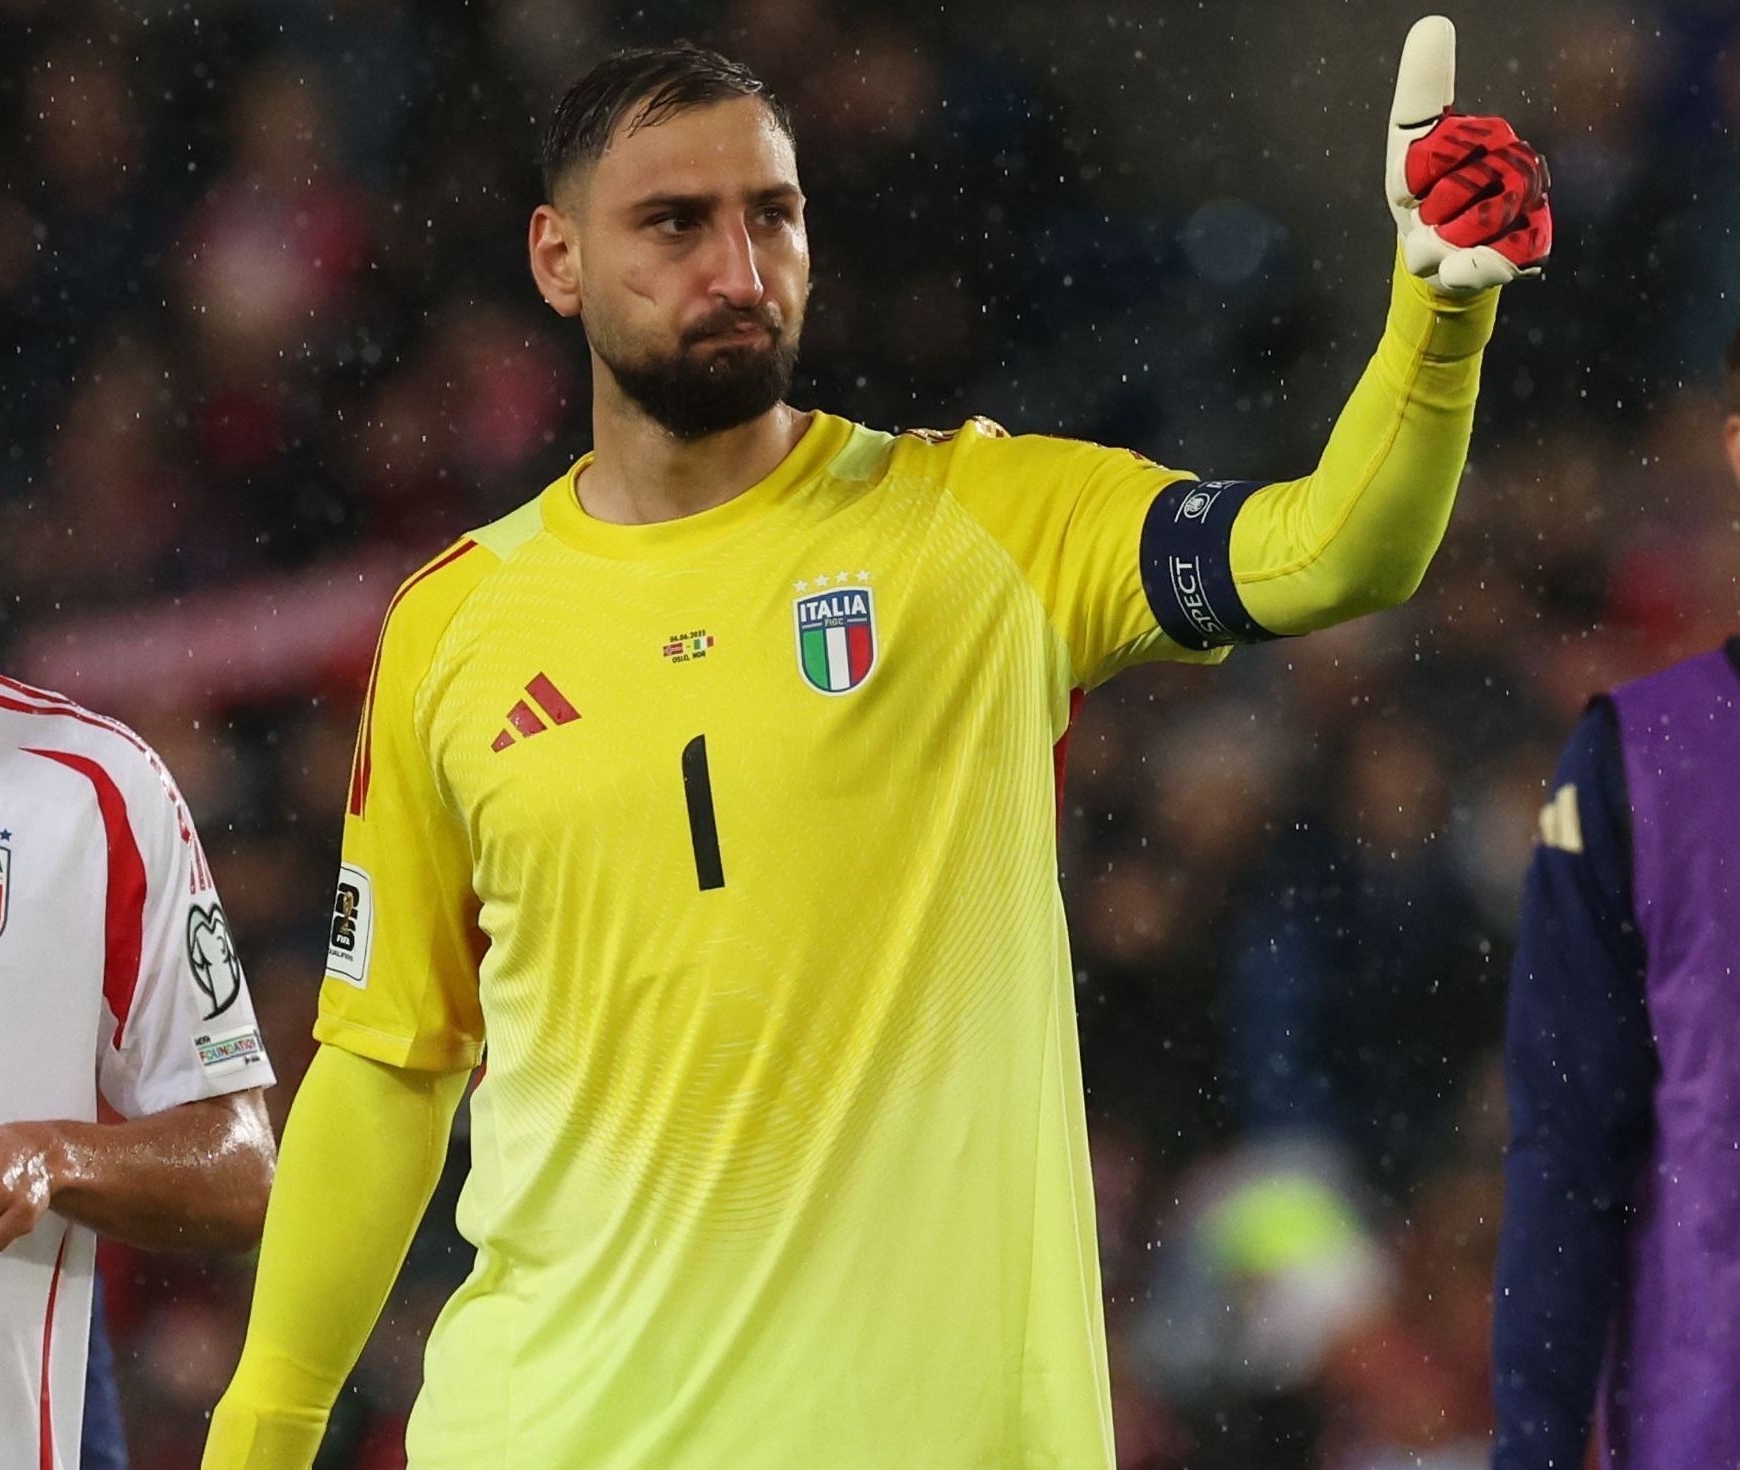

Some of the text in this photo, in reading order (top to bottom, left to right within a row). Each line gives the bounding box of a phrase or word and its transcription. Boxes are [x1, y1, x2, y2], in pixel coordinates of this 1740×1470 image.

[800, 594, 867, 622] ITALIA
[1176, 556, 1222, 634] SPECT
[682, 733, 726, 892] 1
